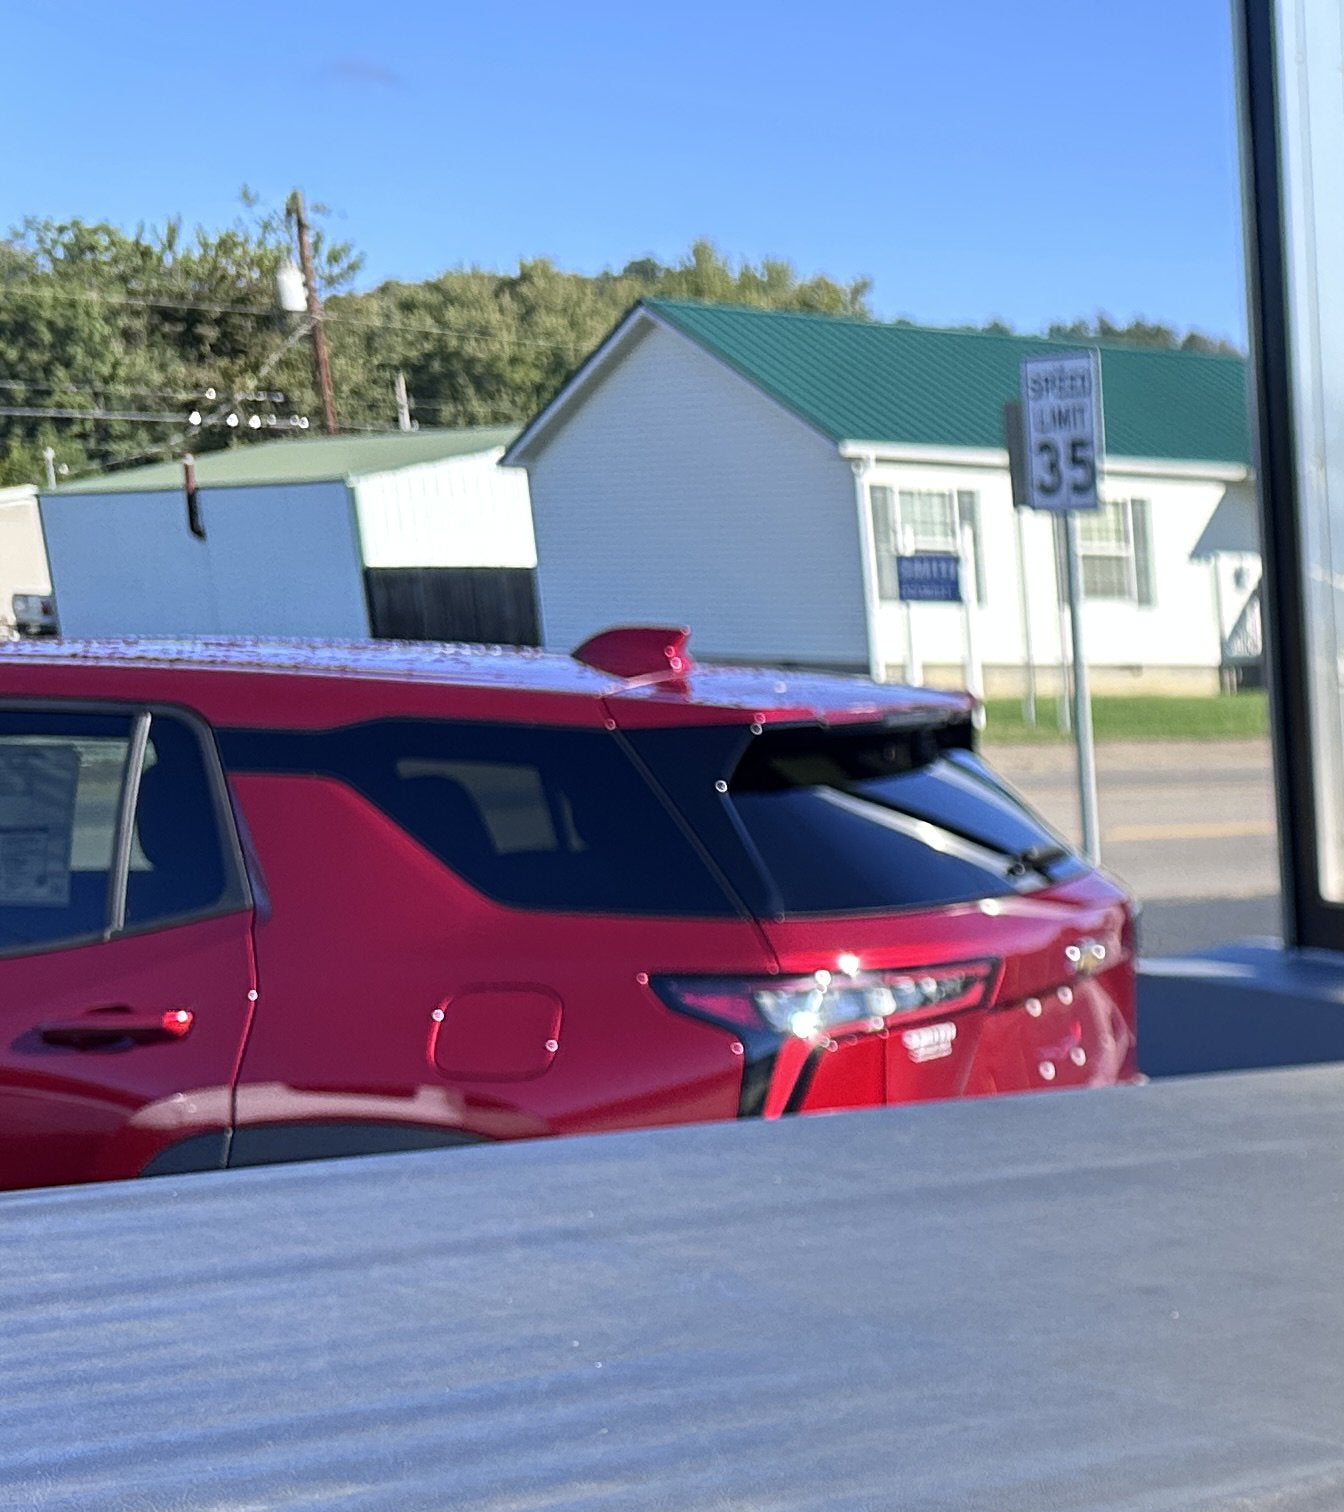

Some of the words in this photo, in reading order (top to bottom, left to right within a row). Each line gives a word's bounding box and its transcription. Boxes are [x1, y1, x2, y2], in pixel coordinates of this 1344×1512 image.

[1030, 373, 1092, 399] SPEED
[1035, 404, 1087, 433] LIMIT
[1037, 437, 1093, 496] 35
